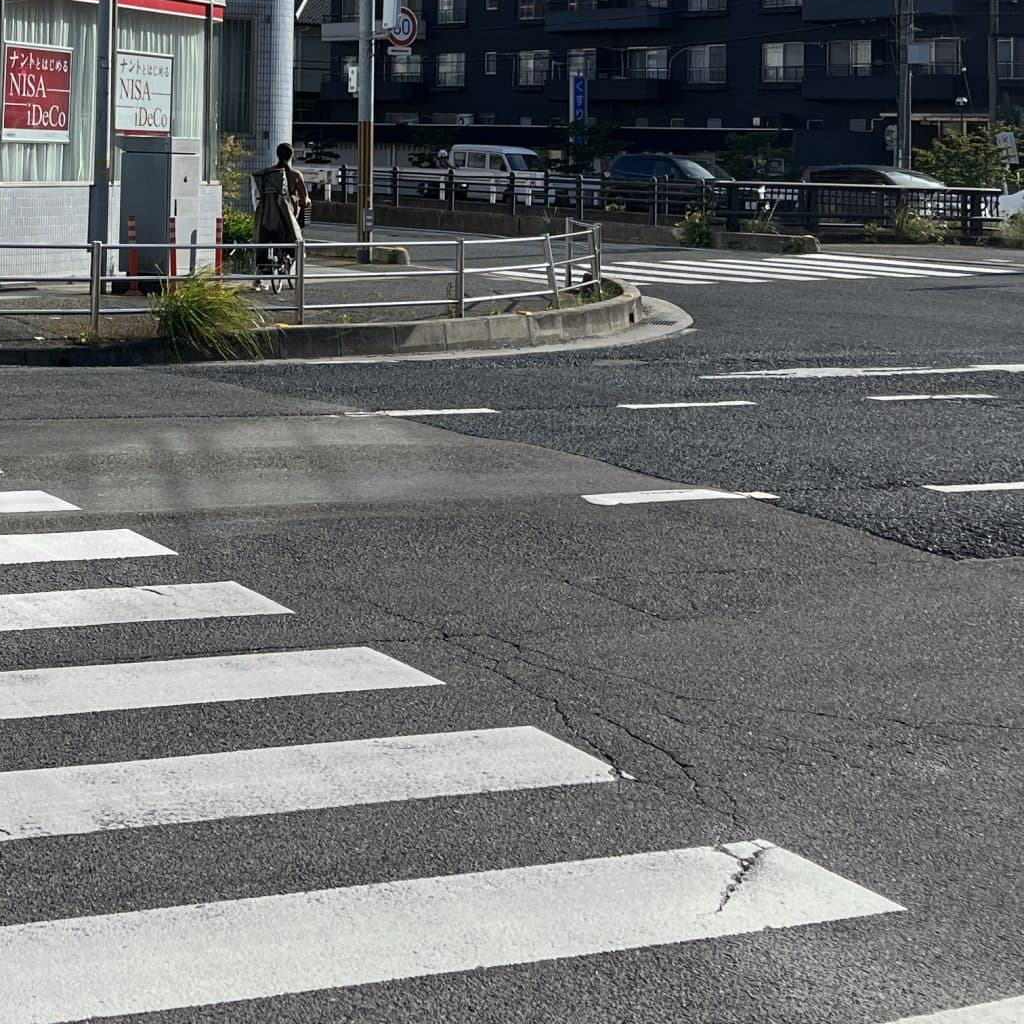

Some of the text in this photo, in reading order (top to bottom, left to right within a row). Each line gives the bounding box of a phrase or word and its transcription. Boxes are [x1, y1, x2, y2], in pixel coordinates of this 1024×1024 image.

[9, 50, 69, 73] ナントとはじめる
[119, 58, 170, 78] ナントとはじめる
[8, 72, 47, 98] NISA
[119, 77, 152, 101] NISA
[575, 80, 584, 121] くすり
[27, 102, 66, 128] iDeCo
[134, 106, 168, 129] iDeCo
